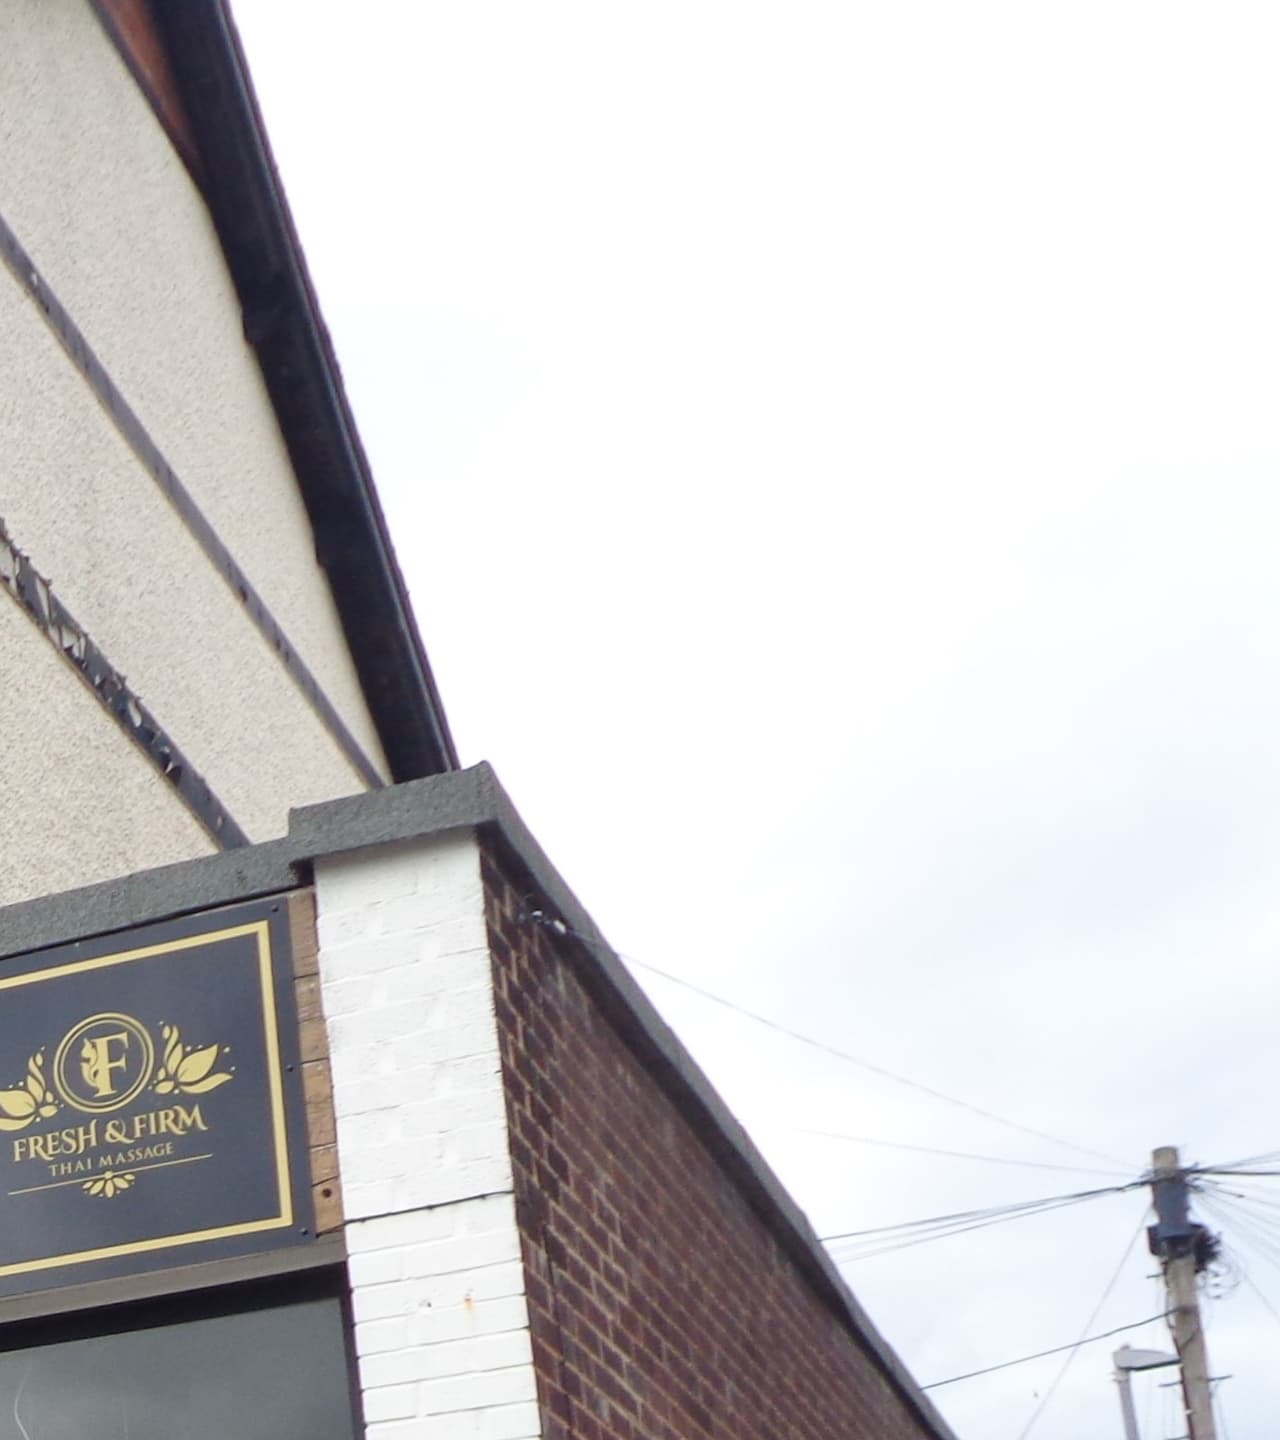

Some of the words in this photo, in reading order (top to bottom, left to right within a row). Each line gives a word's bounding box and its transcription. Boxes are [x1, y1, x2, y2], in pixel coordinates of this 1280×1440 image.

[13, 1119, 98, 1162] FRESH
[105, 1119, 135, 1144] &
[134, 1103, 208, 1138] FIRM
[48, 1159, 93, 1177] THAI
[99, 1142, 174, 1168] MASSAGE
